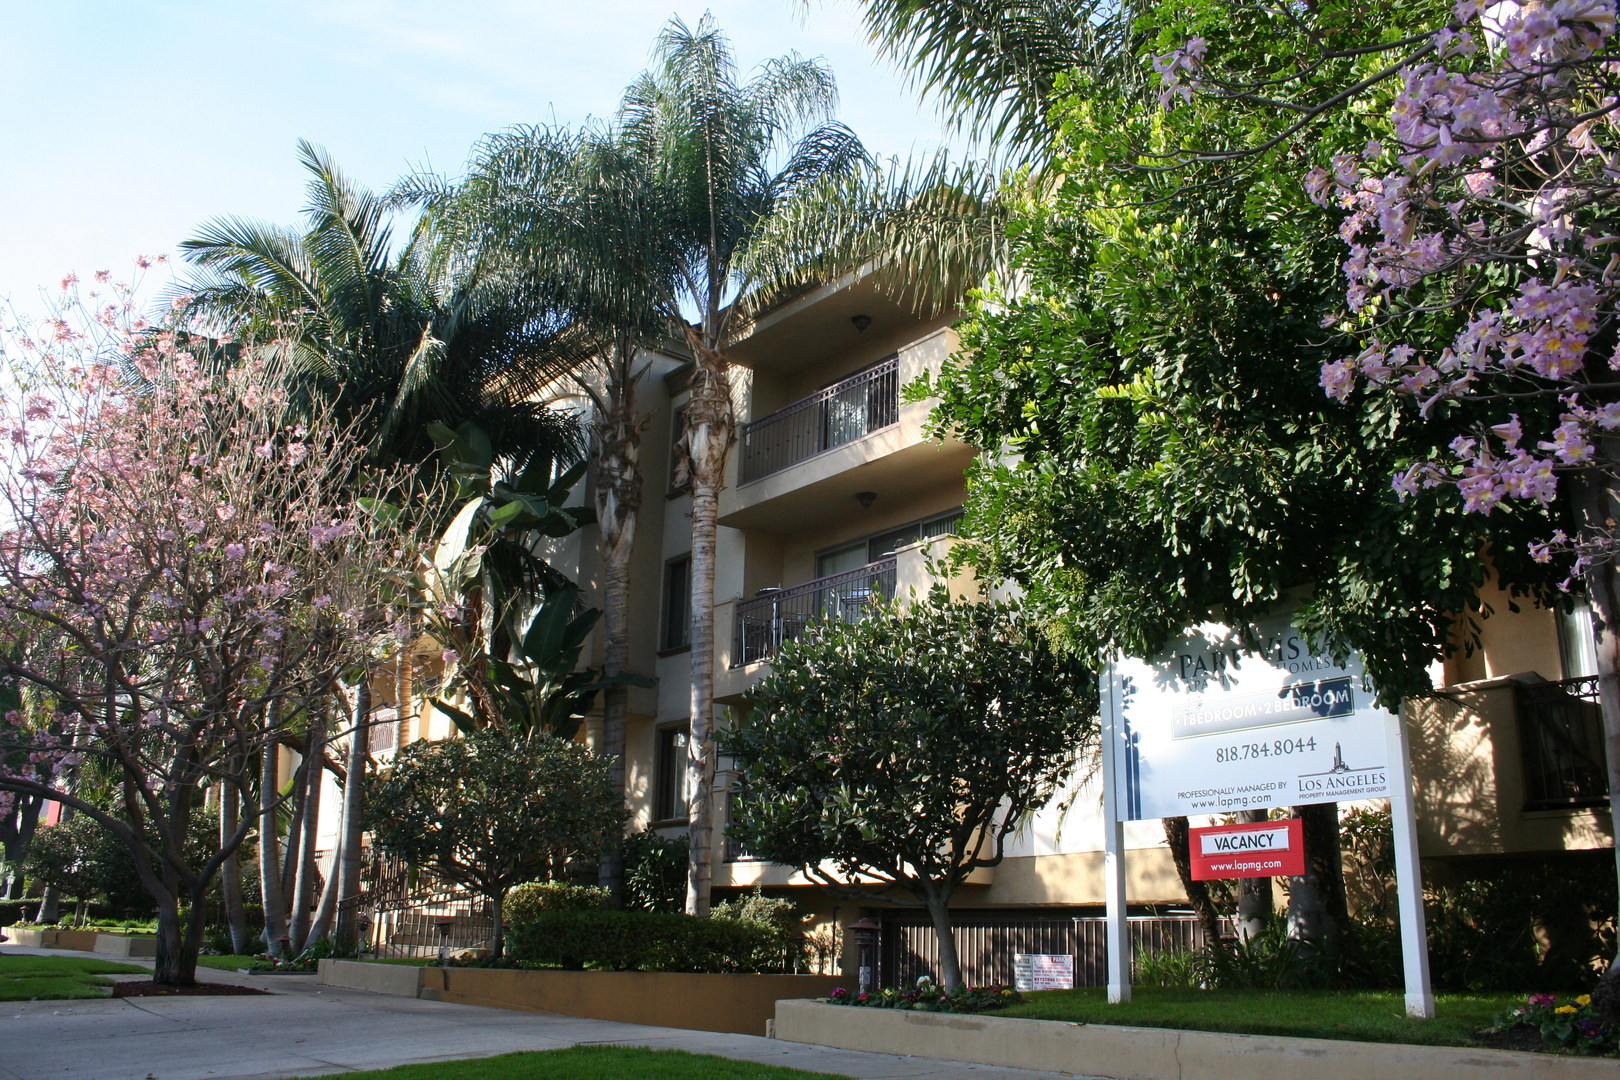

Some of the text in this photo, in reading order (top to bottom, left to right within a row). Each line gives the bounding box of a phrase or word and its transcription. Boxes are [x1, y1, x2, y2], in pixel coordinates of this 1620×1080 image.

[1189, 704, 1257, 726] BEDROOM
[1264, 701, 1272, 715] 2
[1274, 689, 1349, 713] BEDROOM
[1216, 736, 1317, 763] 818.784.8044
[1177, 781, 1287, 800] PROFESSIONALLY MANAGED BY
[1298, 772, 1386, 792] LOS ANGELES
[1299, 785, 1387, 799] PROPERTY MANAGEMENT GROUP
[1191, 794, 1271, 809] www.lapmg.com
[1214, 833, 1274, 851] VACANCY
[1211, 859, 1282, 873] www.lapmg.com
